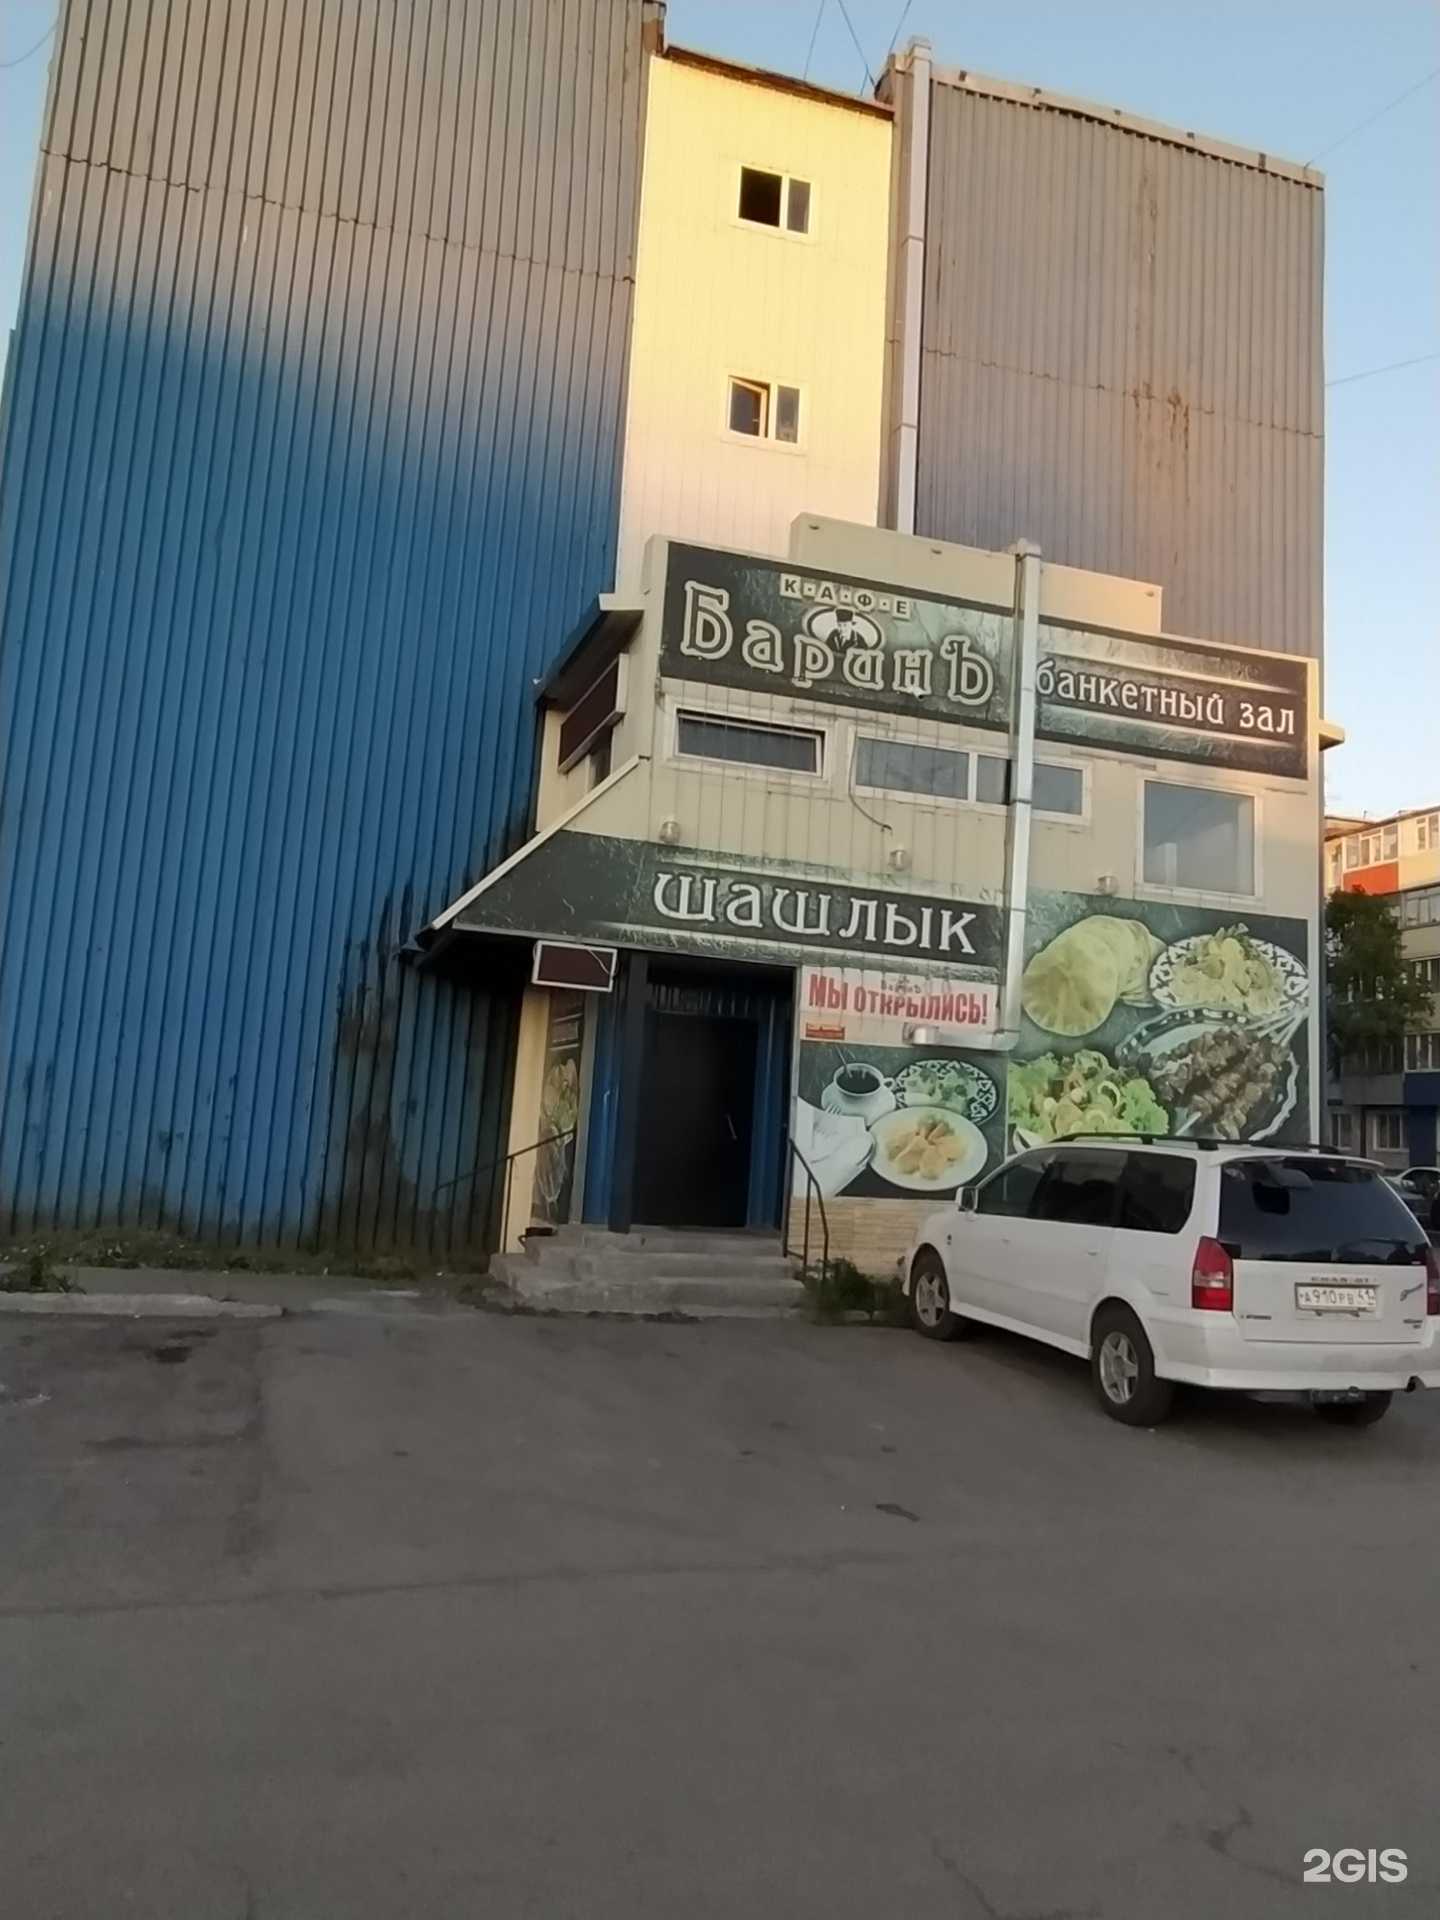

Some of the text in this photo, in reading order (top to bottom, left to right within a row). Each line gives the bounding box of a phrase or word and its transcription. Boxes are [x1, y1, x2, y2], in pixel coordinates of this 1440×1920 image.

[1036, 657, 1295, 735] банкетный зал
[808, 974, 849, 1011] МЫ
[854, 986, 988, 1025] ОТКРЫЛИСЬ!
